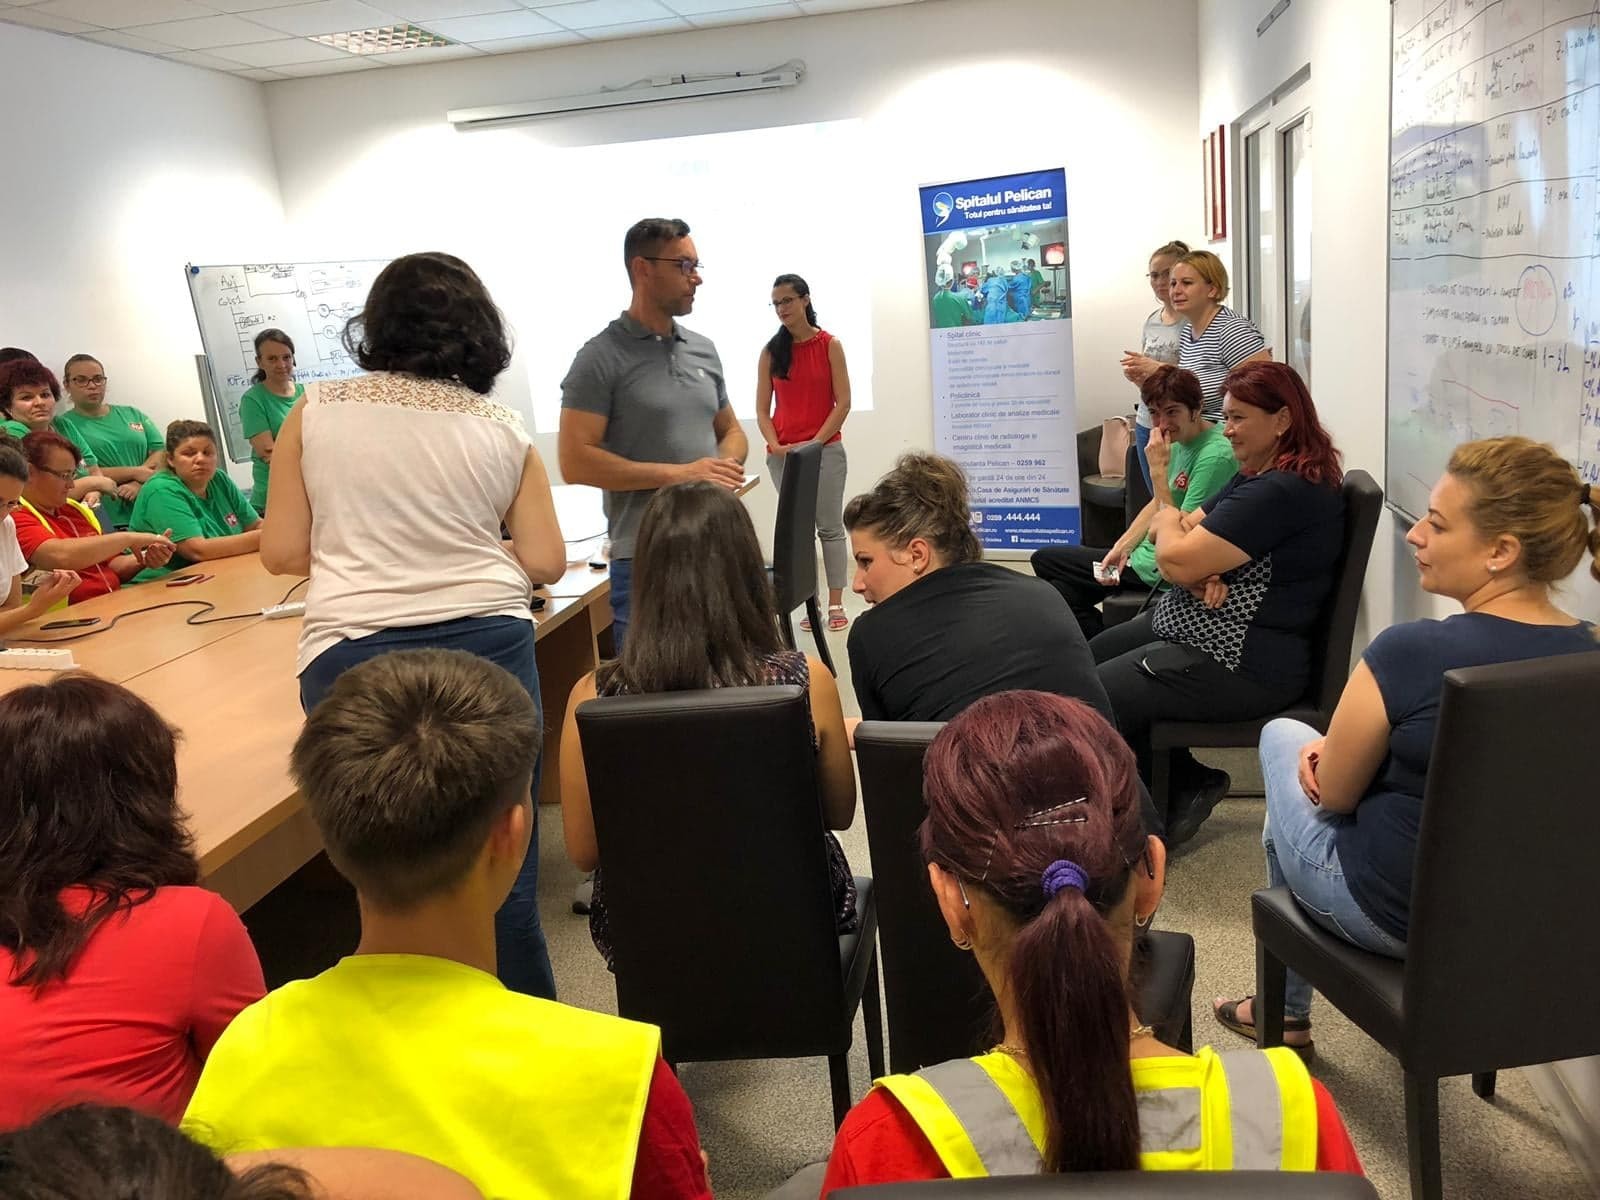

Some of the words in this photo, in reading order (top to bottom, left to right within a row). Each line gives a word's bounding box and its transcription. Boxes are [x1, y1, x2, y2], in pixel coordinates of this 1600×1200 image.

[955, 192, 1002, 210] Spitalul
[1004, 188, 1052, 203] Pelican
[983, 207, 1006, 218] pentru
